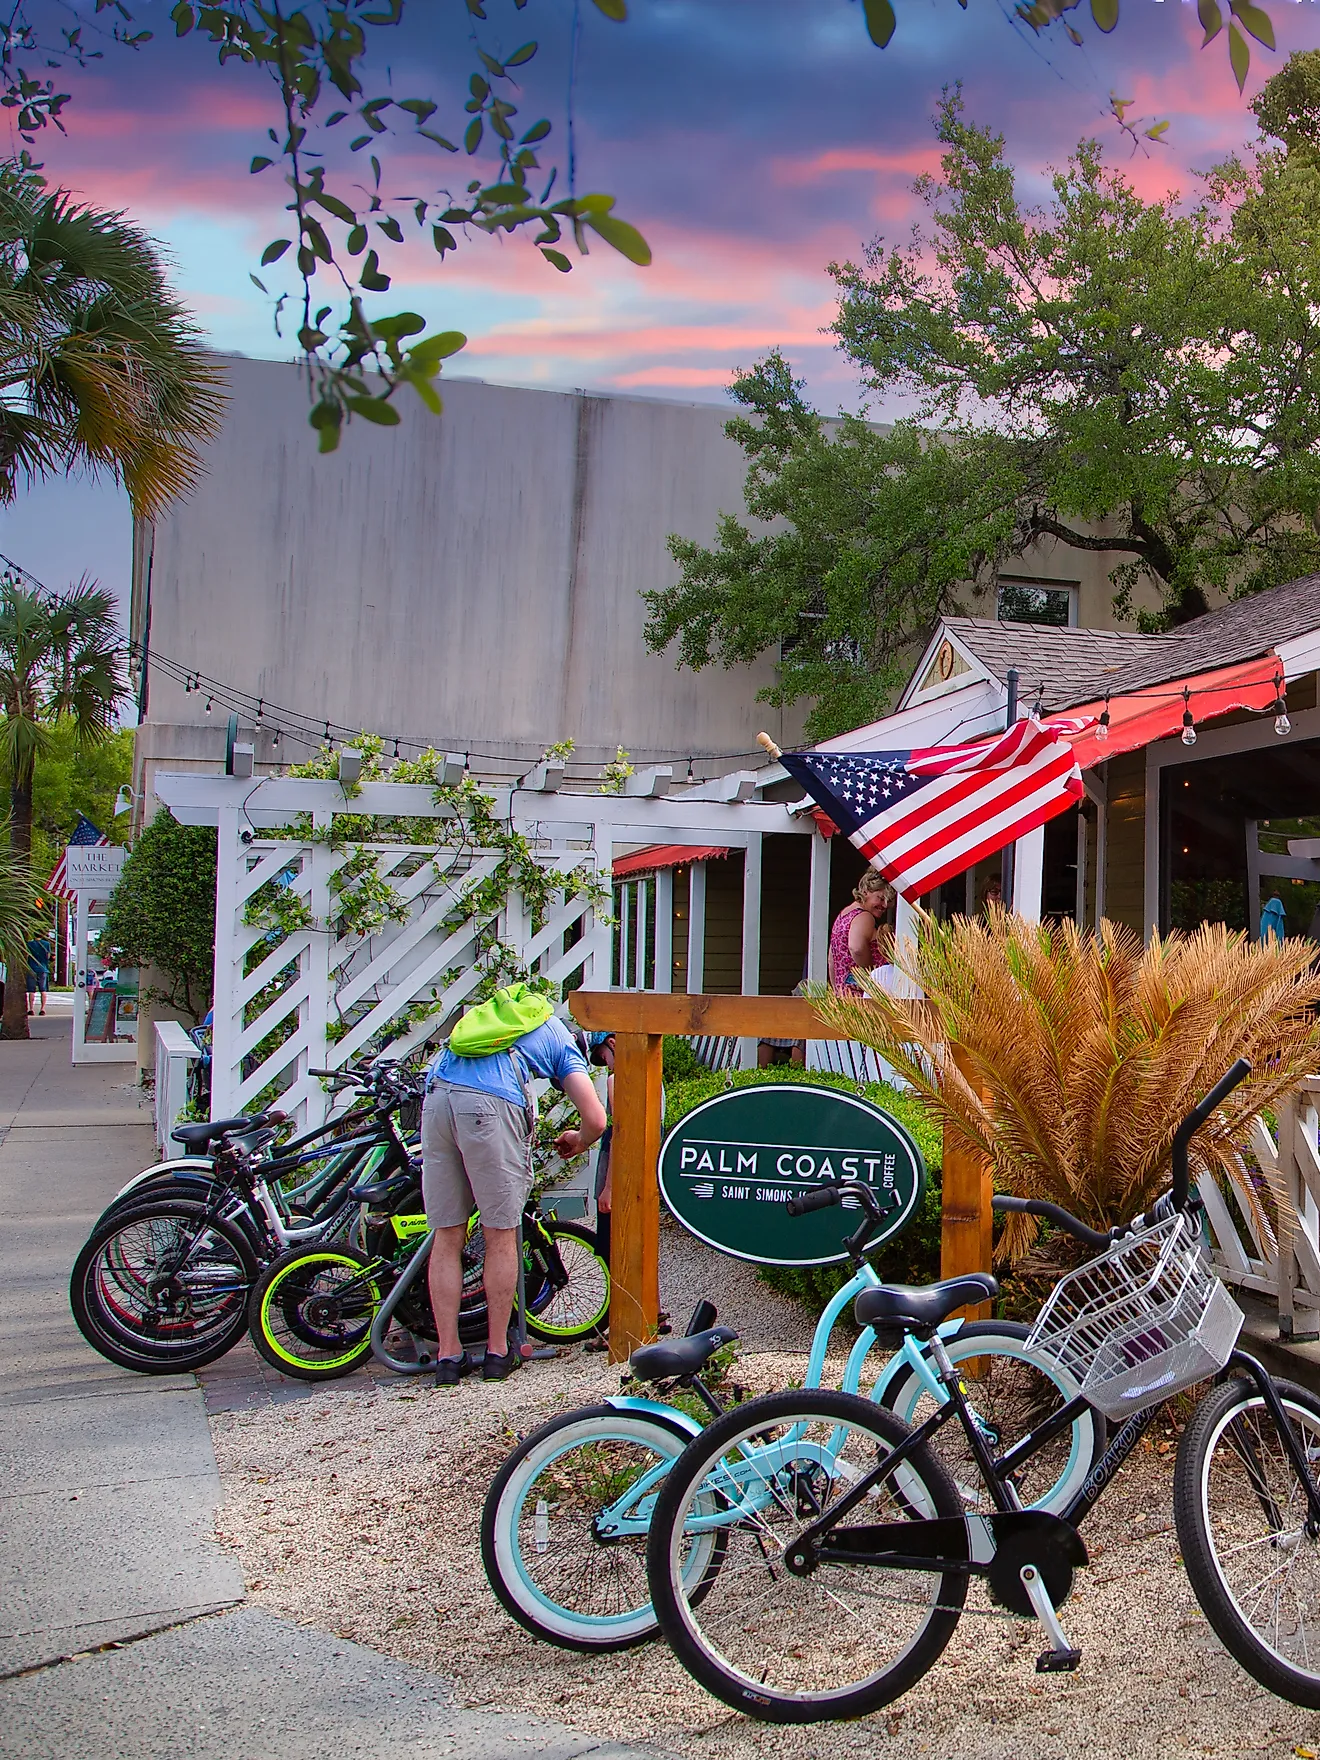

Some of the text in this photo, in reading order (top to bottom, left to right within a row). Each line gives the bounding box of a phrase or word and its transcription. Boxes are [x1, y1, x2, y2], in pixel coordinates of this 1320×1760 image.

[86, 853, 107, 861] THE
[72, 863, 121, 872] MARKET
[680, 1147, 881, 1182] PALM COAST
[882, 1153, 896, 1188] COFFEE
[721, 1185, 751, 1200] SAINT
[755, 1187, 793, 1202] SIMONS
